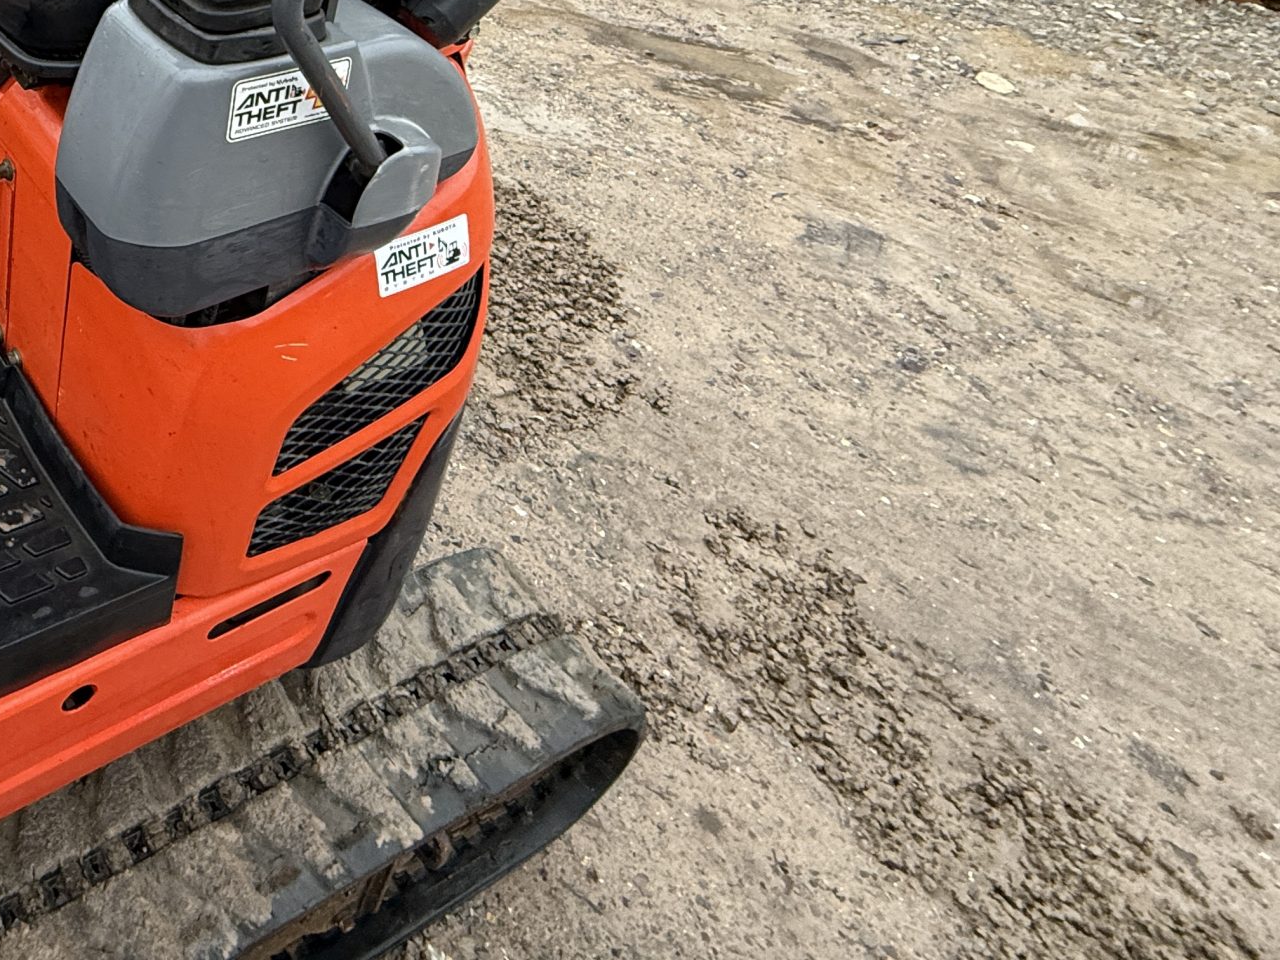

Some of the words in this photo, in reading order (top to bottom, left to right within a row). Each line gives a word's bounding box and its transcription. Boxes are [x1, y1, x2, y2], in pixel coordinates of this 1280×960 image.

[236, 85, 291, 111] ANTI
[234, 99, 302, 127] THEFT
[380, 253, 437, 285] THEFT
[381, 241, 427, 271] ANTI
